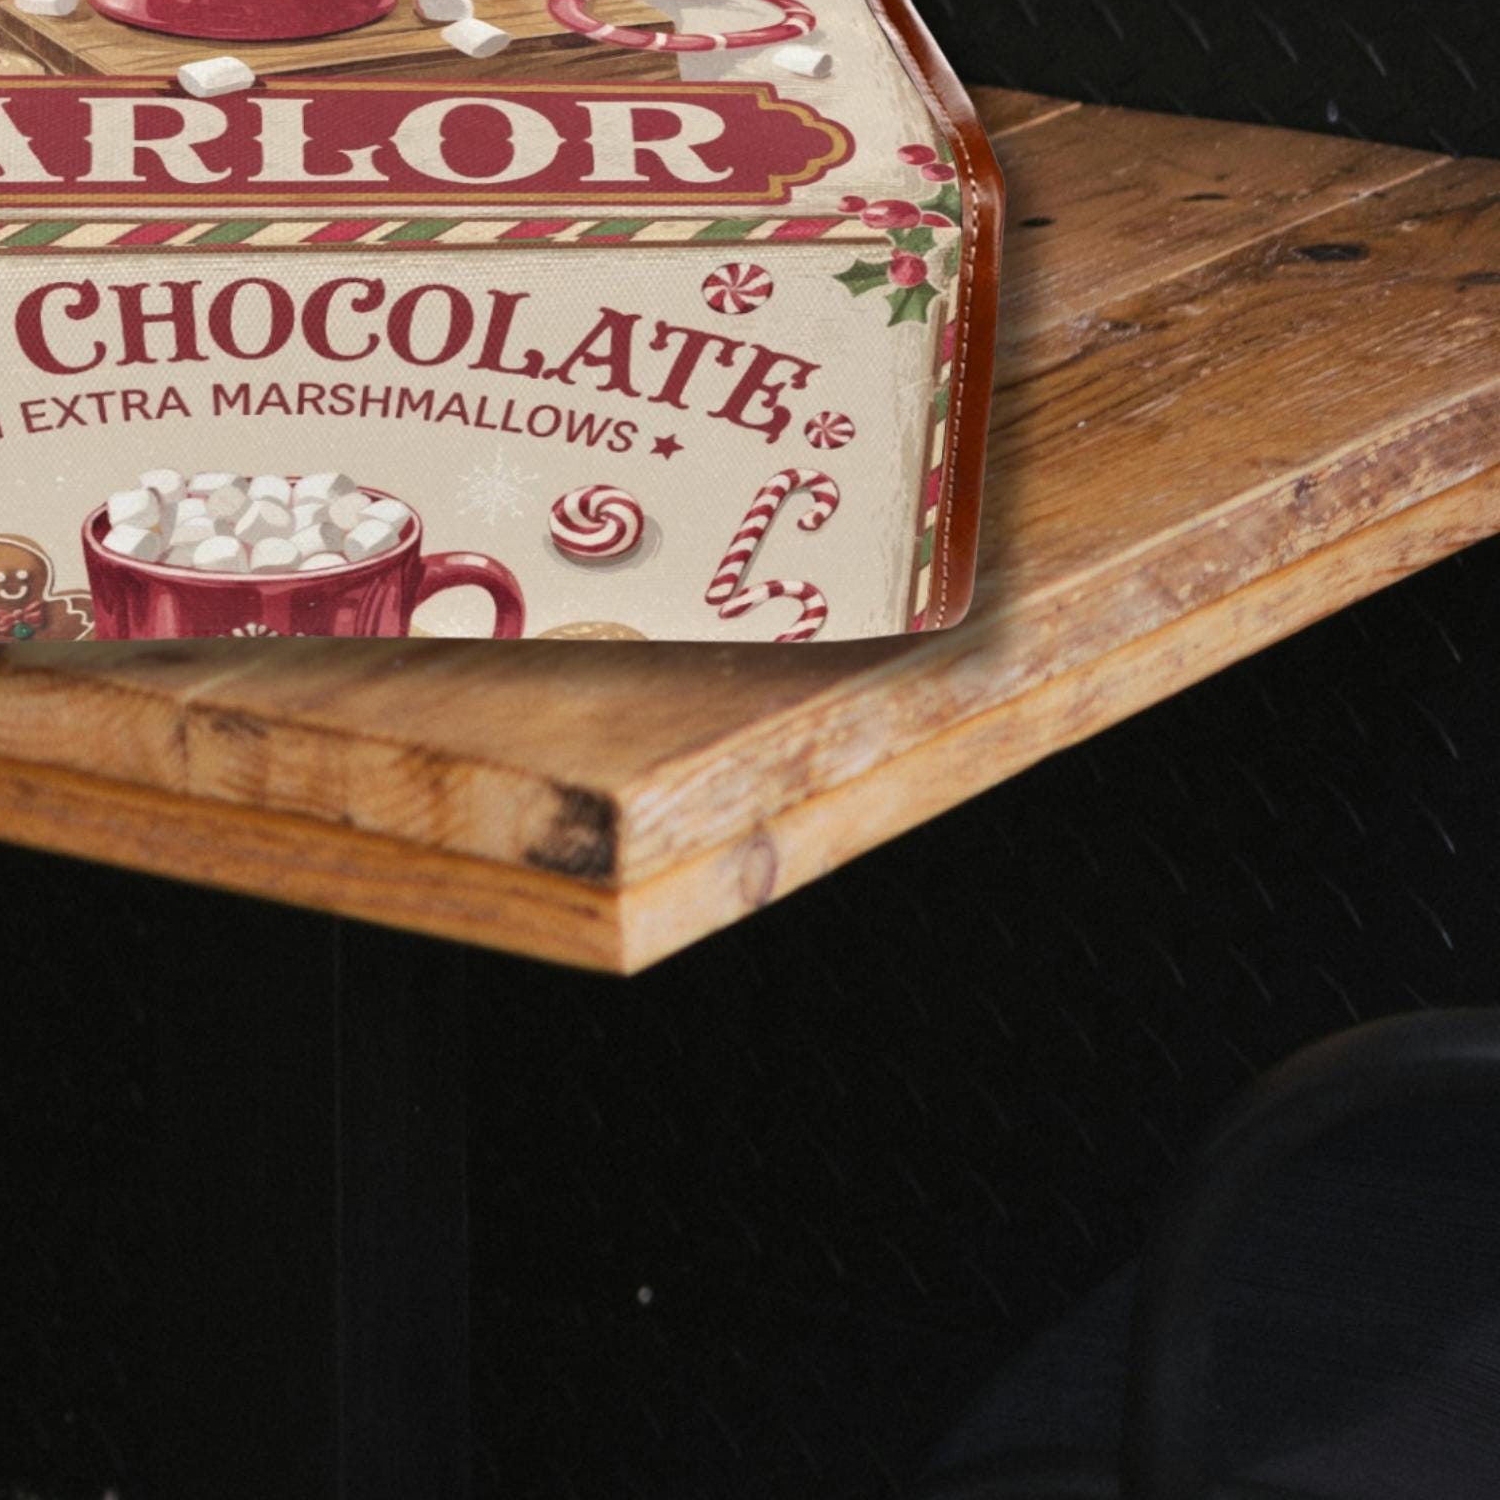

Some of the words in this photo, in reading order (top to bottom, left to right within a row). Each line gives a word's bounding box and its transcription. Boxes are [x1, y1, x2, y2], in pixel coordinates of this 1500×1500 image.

[15, 276, 821, 443] CHOCOLATE
[20, 386, 191, 436] EXTRA
[212, 382, 639, 453] MARSHMALLOWS
